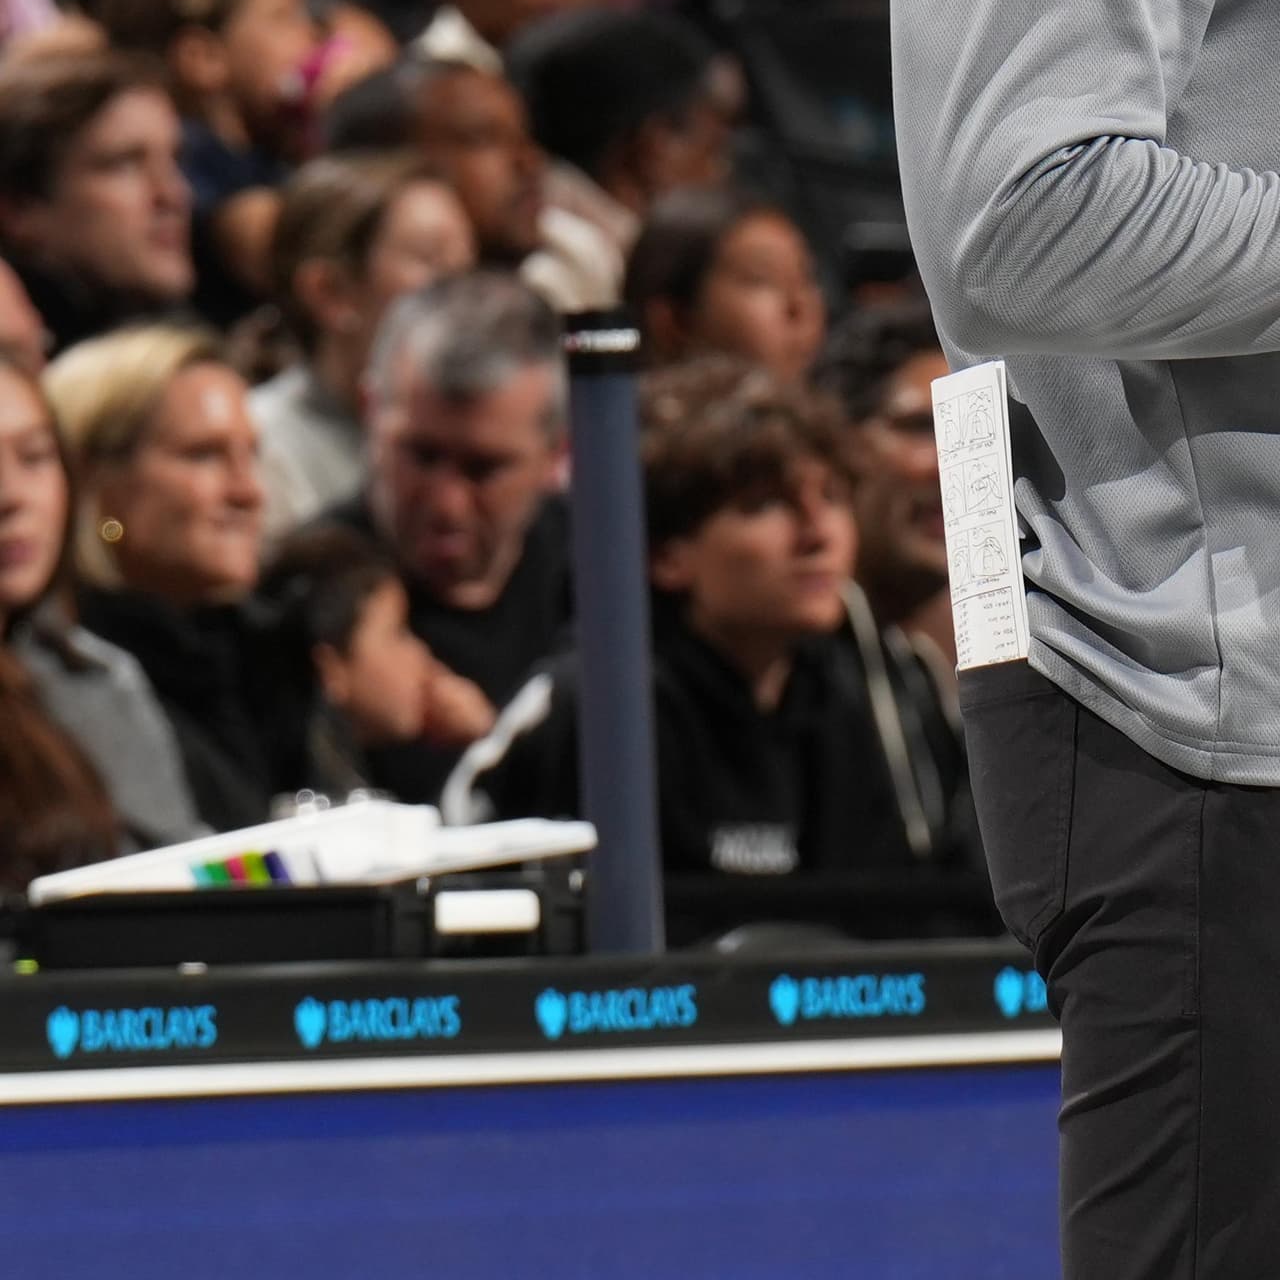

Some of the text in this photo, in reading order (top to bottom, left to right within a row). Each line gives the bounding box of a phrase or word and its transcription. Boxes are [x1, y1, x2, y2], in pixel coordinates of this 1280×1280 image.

[326, 995, 461, 1042] BARCLAYS
[568, 984, 697, 1033] BARCLAYS
[799, 973, 926, 1018] BARCLAYS
[81, 1005, 217, 1052] BARCLAYS
